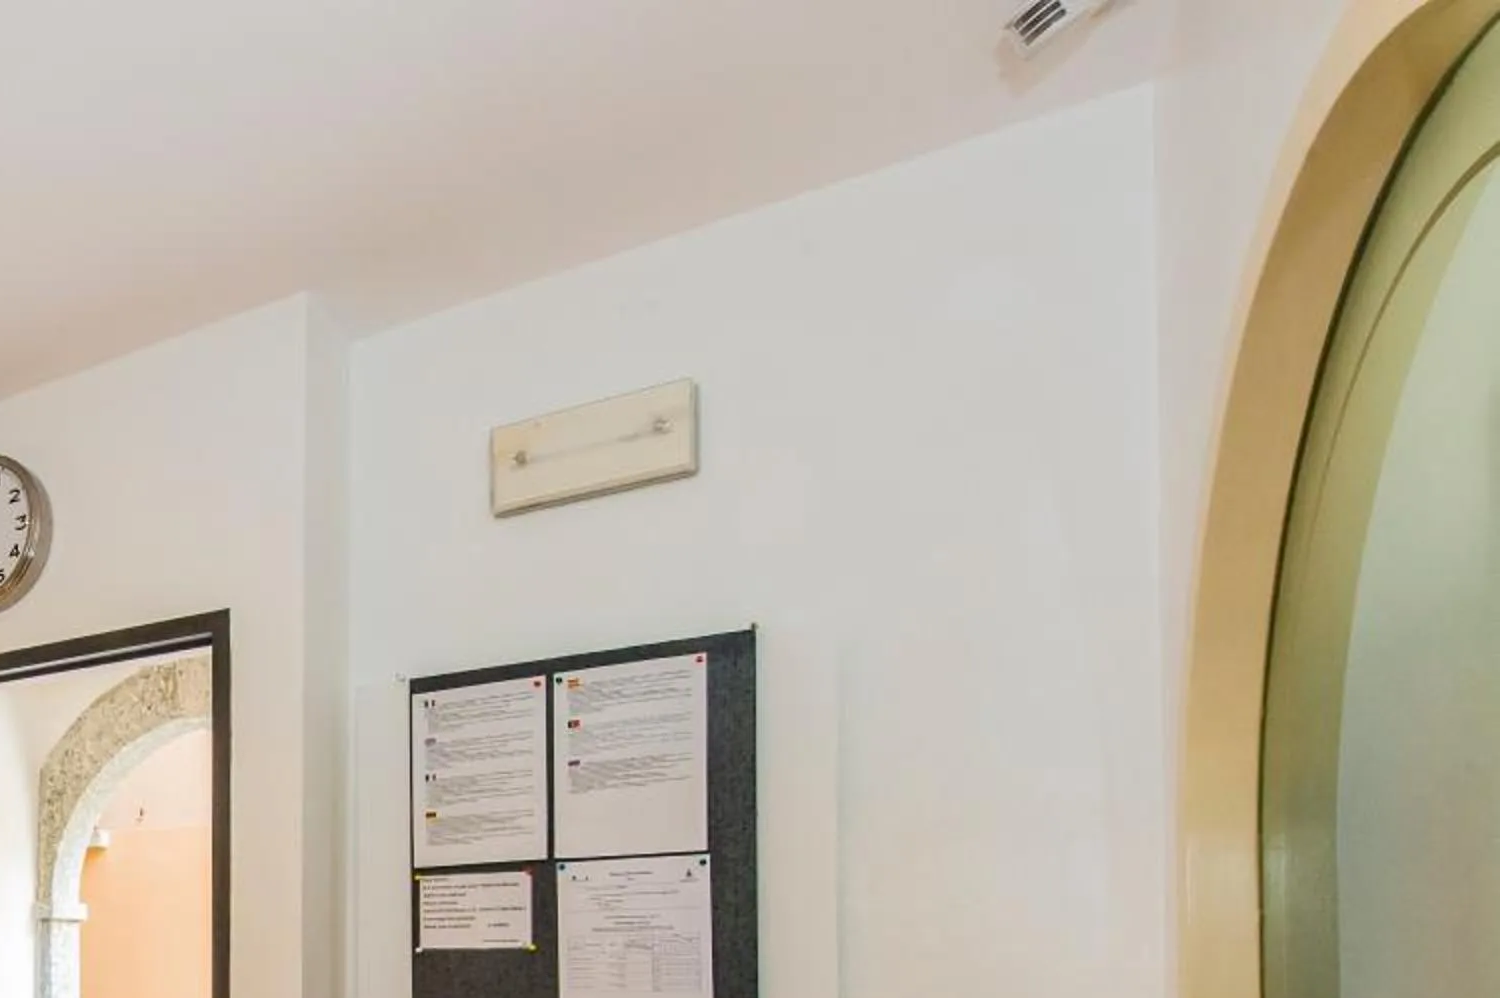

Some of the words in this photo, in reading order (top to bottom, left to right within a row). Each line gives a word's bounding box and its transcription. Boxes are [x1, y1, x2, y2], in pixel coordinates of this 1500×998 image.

[8, 489, 21, 504] 2
[14, 513, 27, 531] 3
[9, 543, 21, 558] 4
